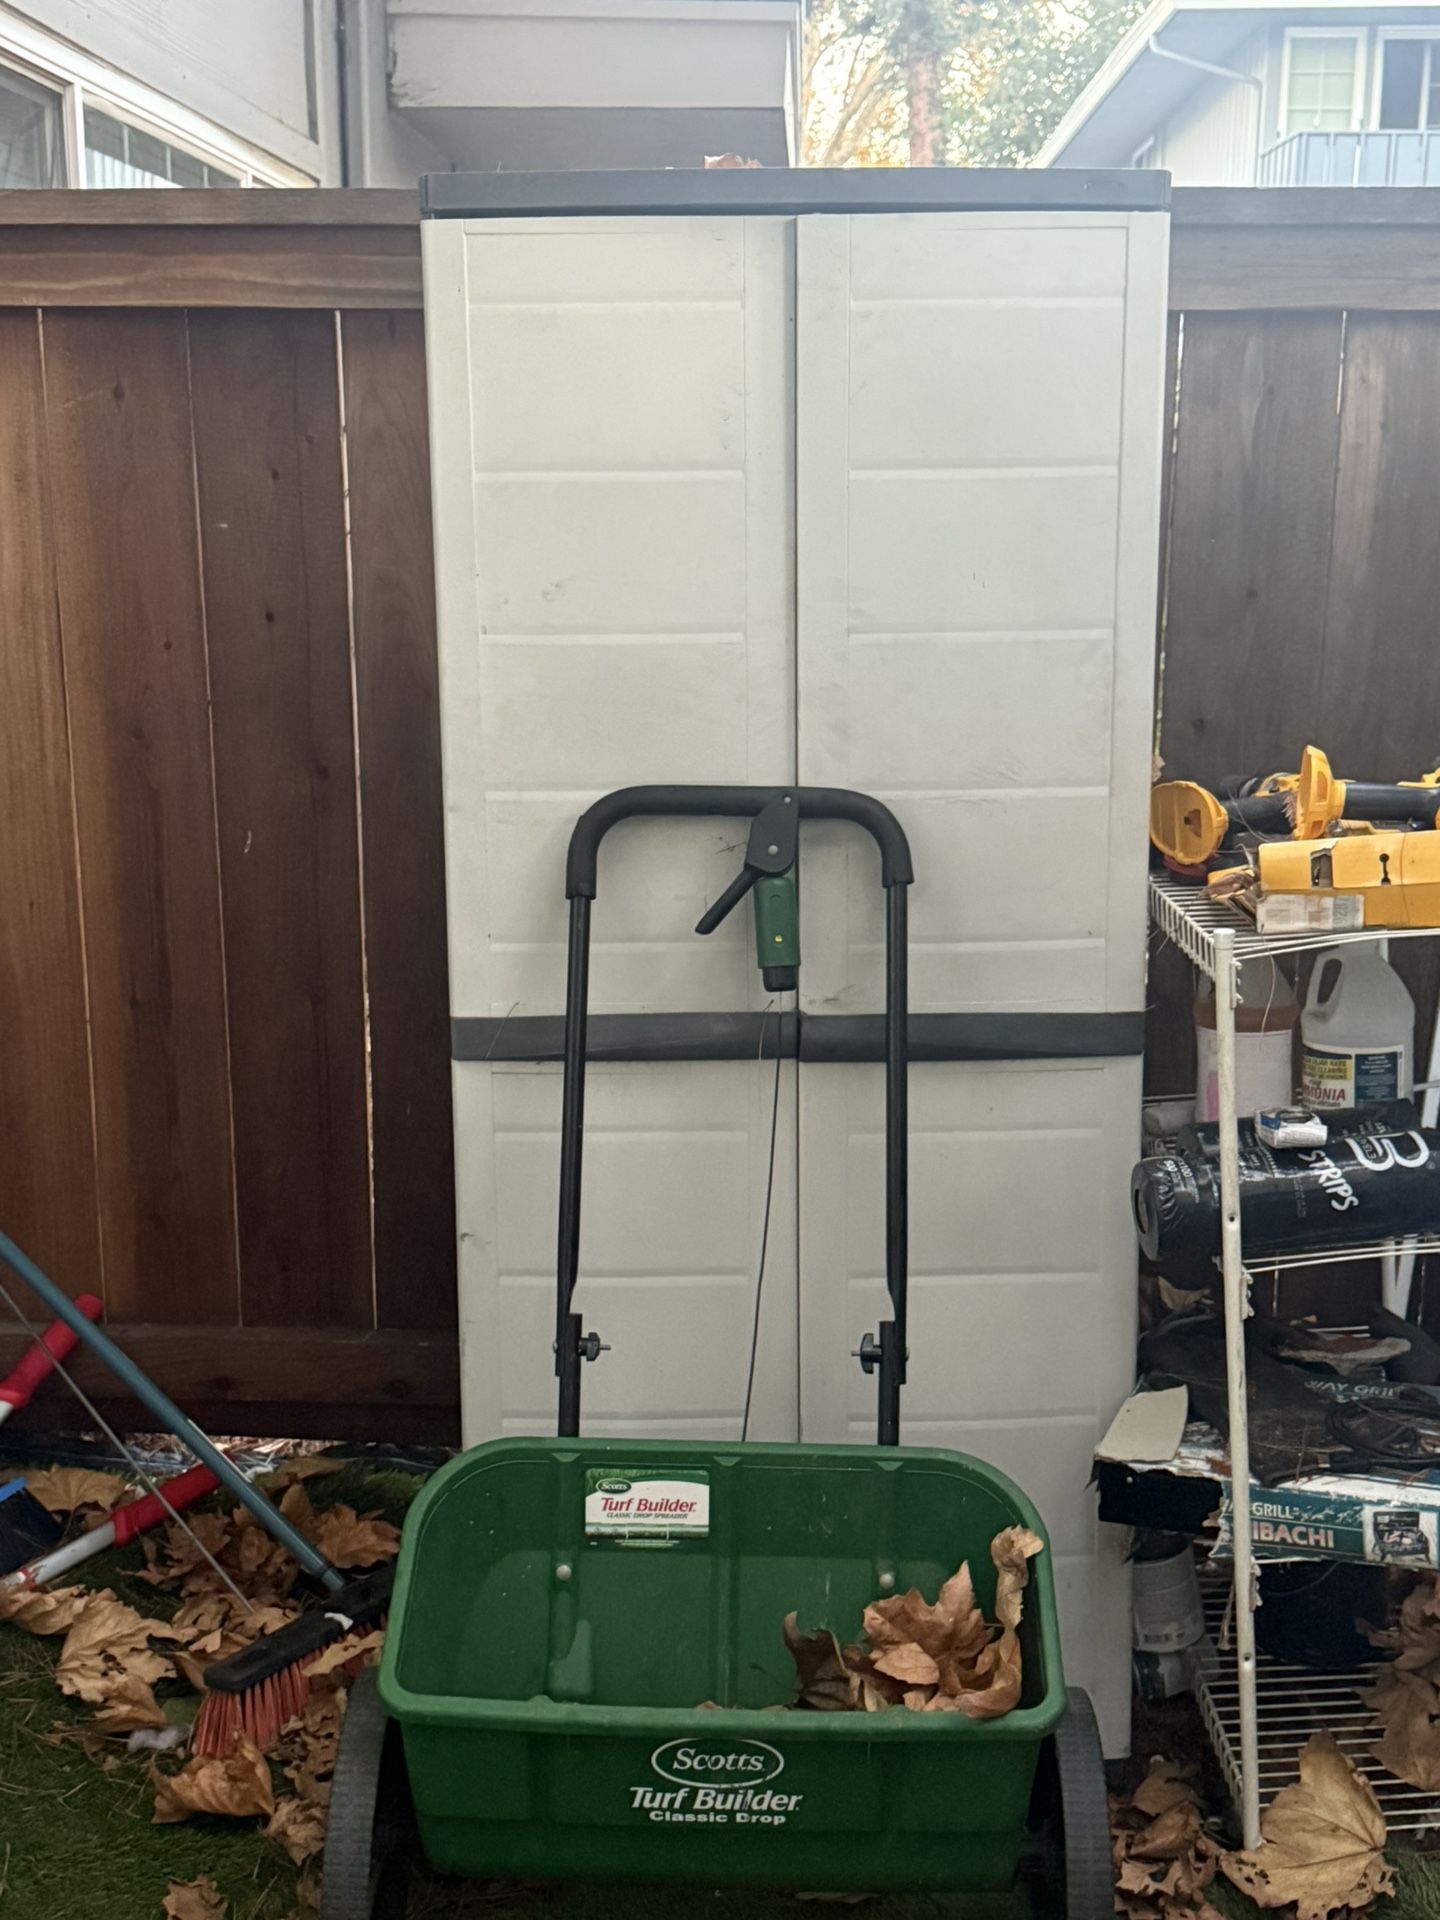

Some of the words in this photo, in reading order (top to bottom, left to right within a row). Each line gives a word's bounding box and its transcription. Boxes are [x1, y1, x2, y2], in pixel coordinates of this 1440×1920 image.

[1297, 1150, 1359, 1211] STRIPS
[601, 1481, 628, 1490] Scotts
[601, 1497, 635, 1511] Turf
[636, 1498, 697, 1513] Builder
[1249, 1521, 1335, 1548] IBACHI
[672, 1748, 764, 1771] Scotts
[630, 1787, 690, 1809] Turf
[693, 1788, 803, 1812] Builder
[649, 1811, 728, 1823] Classic
[735, 1812, 786, 1826] Drop
